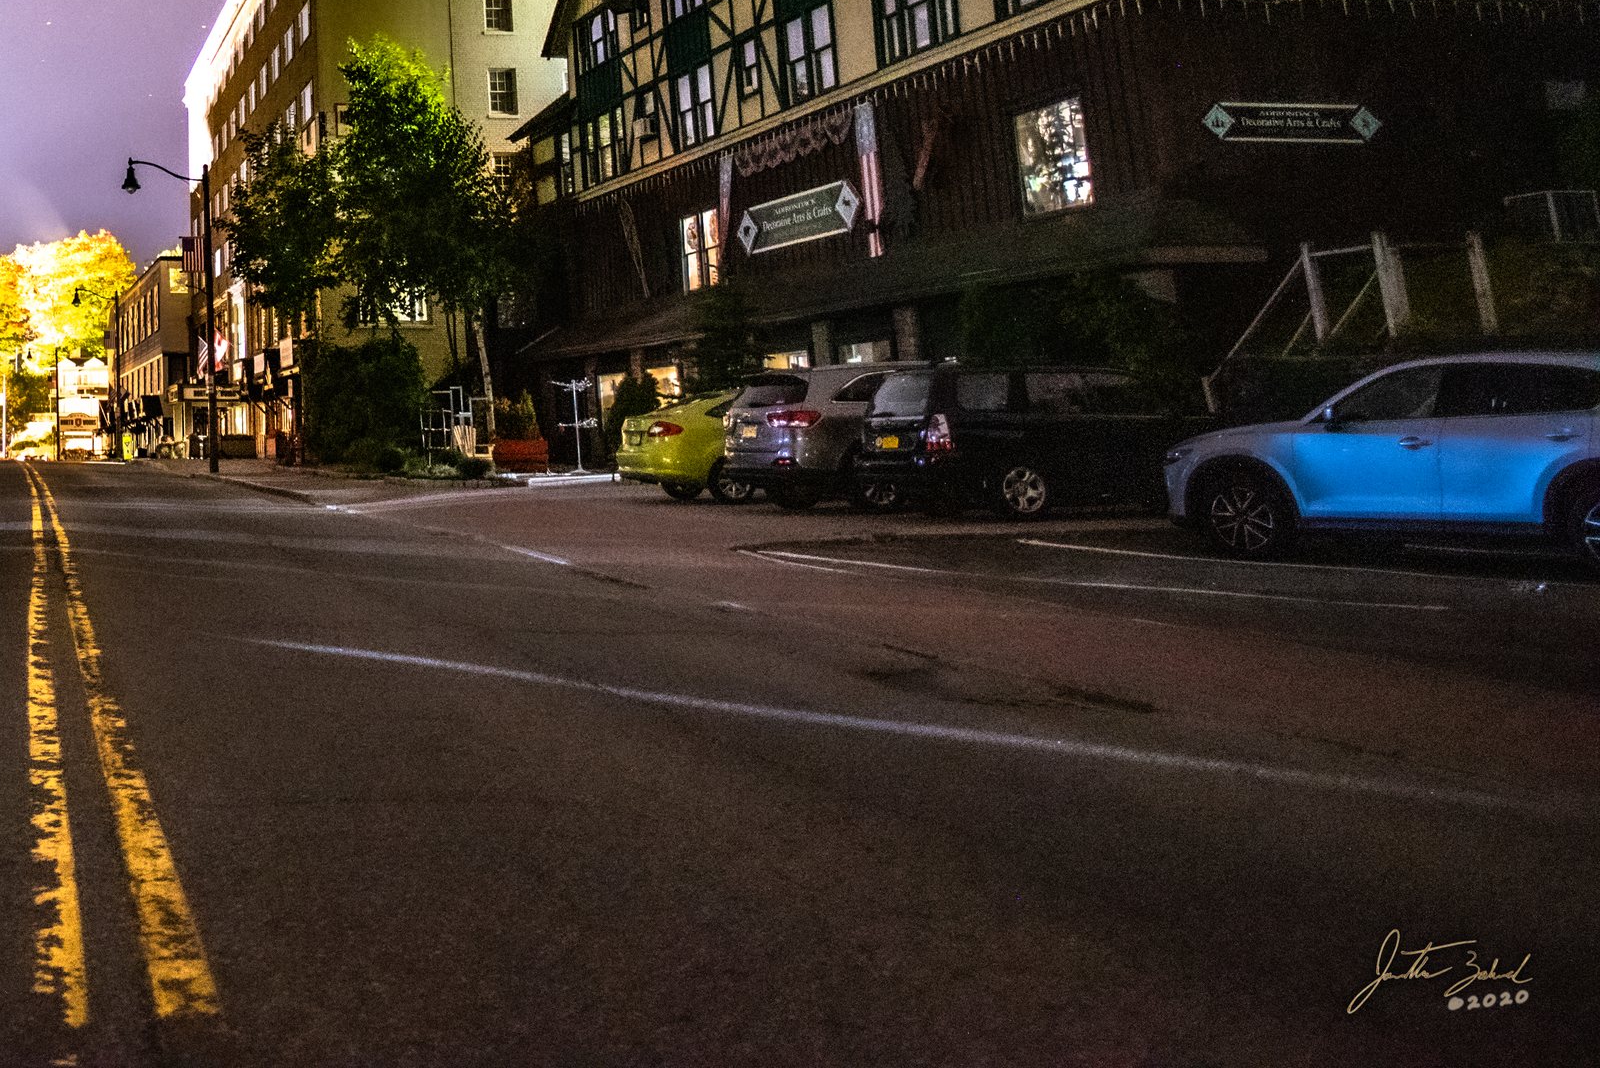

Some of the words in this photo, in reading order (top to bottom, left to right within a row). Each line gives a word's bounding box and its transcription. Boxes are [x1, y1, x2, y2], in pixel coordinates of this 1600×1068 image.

[1241, 116, 1285, 126] Decorative
[1286, 118, 1305, 127] Arts
[1306, 118, 1314, 127] &
[1316, 118, 1342, 128] Crafts
[762, 217, 791, 232] Decorative
[792, 213, 806, 224] Arts
[806, 210, 812, 221] &
[813, 204, 833, 218] Crafts
